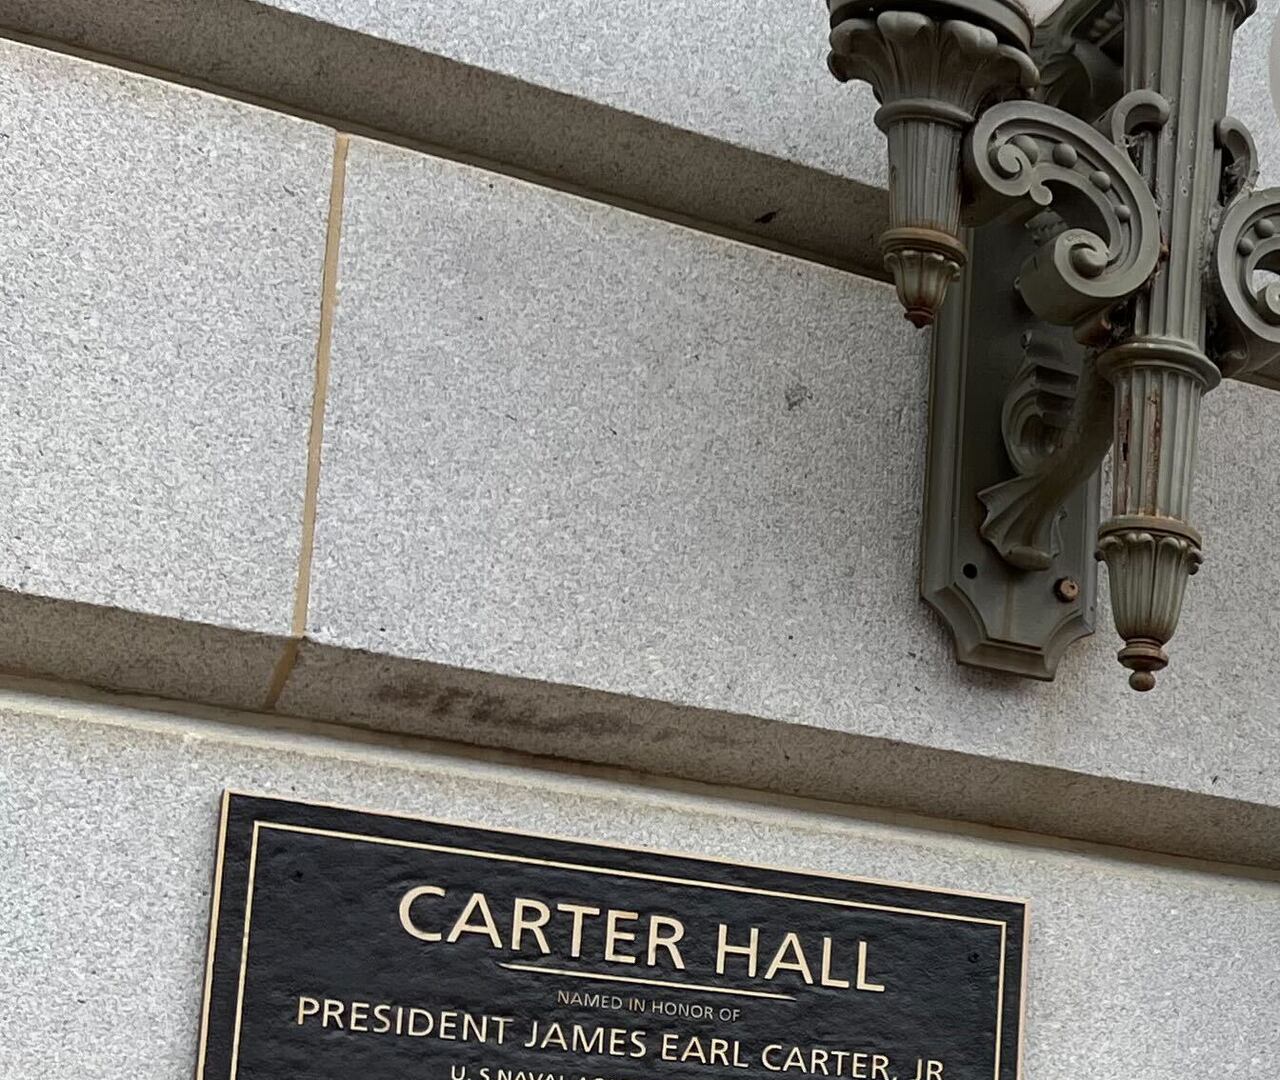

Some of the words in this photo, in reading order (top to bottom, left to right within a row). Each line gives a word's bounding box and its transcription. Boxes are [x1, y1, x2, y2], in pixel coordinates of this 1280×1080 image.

[398, 885, 686, 970] CARTER
[715, 923, 886, 992] HALL
[297, 995, 515, 1045] PRESIDENT
[524, 1020, 647, 1058] JAMES
[661, 1033, 749, 1068] EARL
[557, 989, 623, 1010] NAMED
[628, 997, 646, 1012] IN
[651, 1000, 714, 1020] HONOR
[719, 1008, 741, 1022] OF
